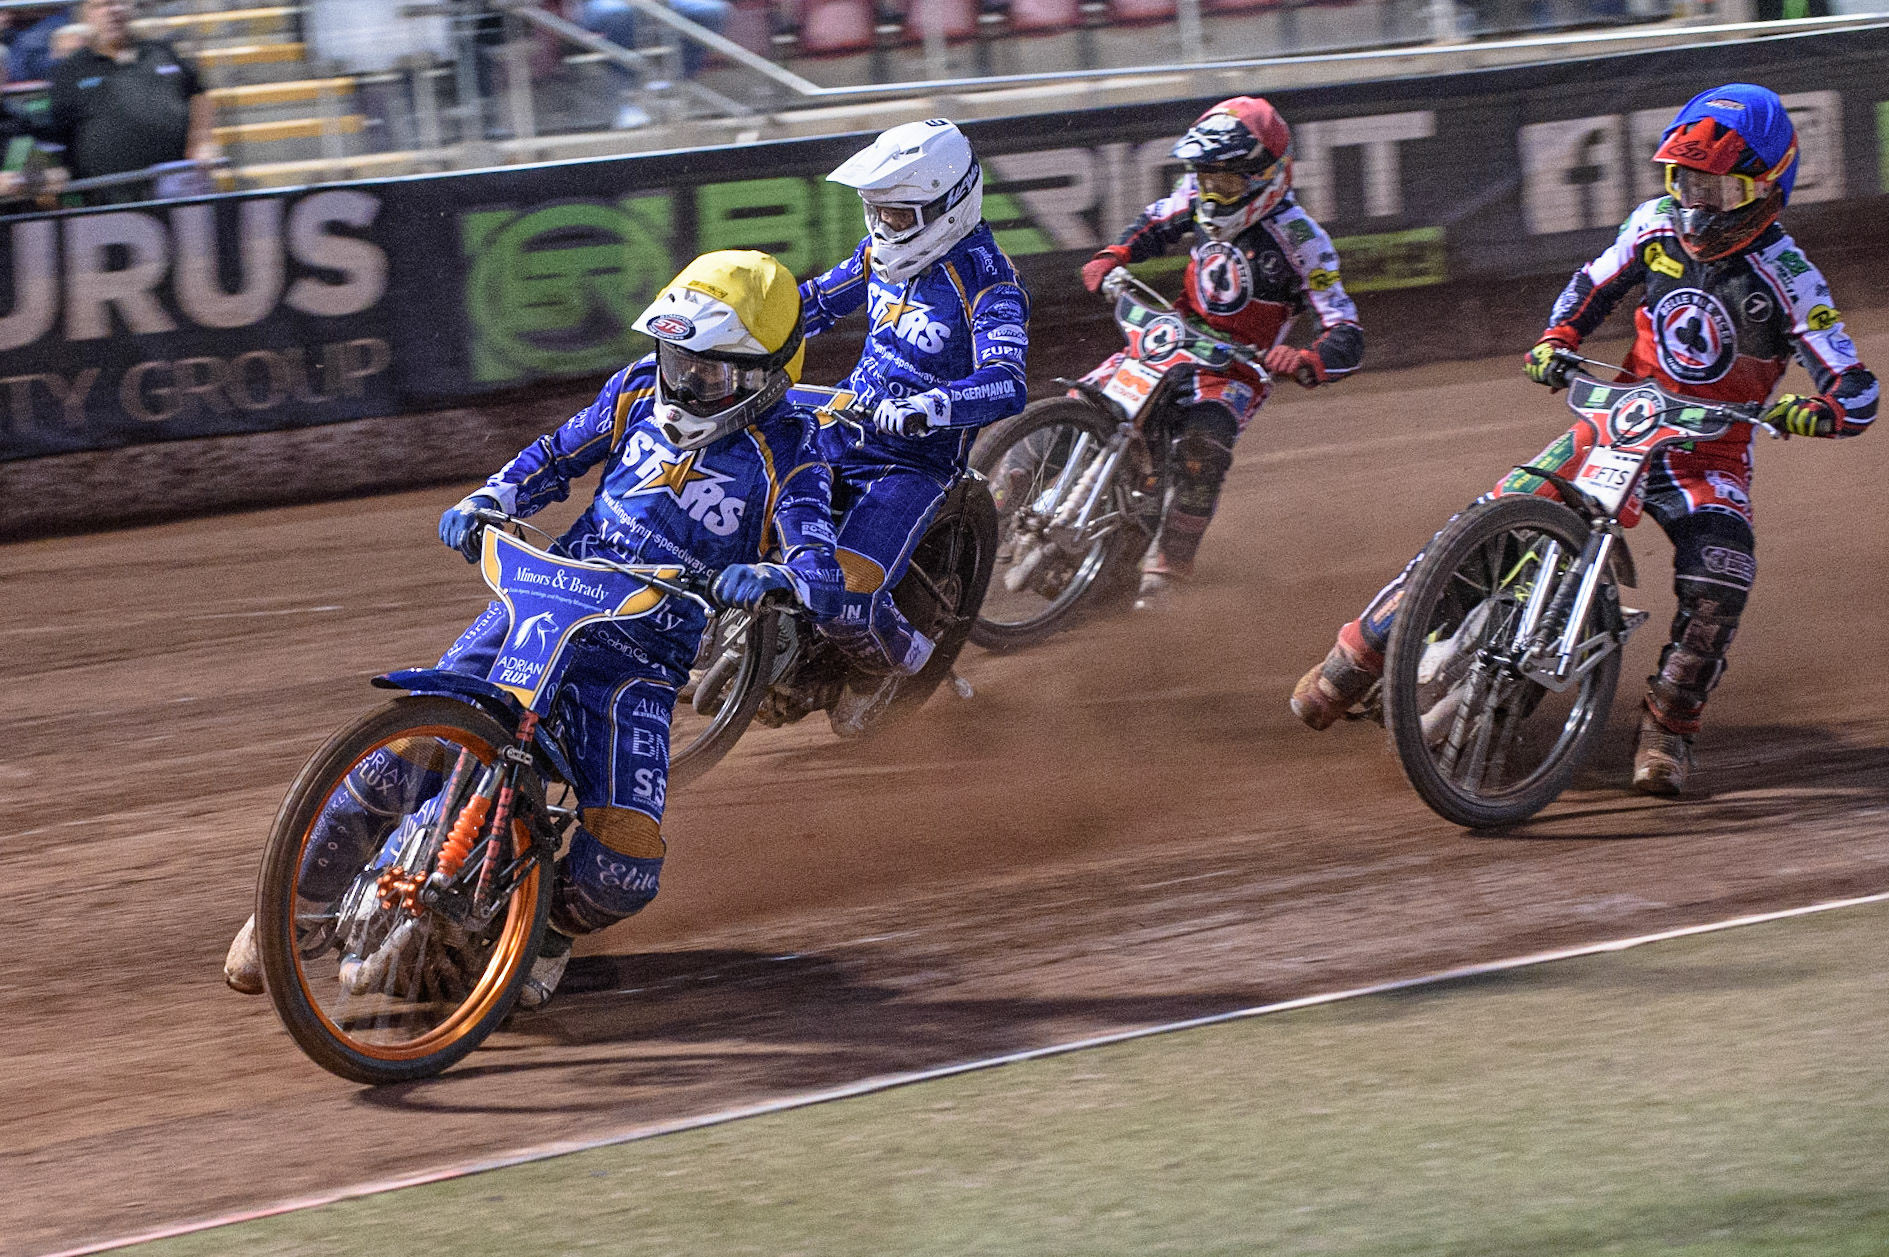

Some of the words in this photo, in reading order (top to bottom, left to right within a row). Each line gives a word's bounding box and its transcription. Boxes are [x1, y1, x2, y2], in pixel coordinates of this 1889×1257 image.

[118, 337, 392, 423] GROUP
[513, 566, 550, 586] Minors
[552, 569, 569, 589] &
[569, 576, 609, 604] Brady
[497, 655, 545, 676] ADRIAN
[499, 669, 532, 686] FLUX
